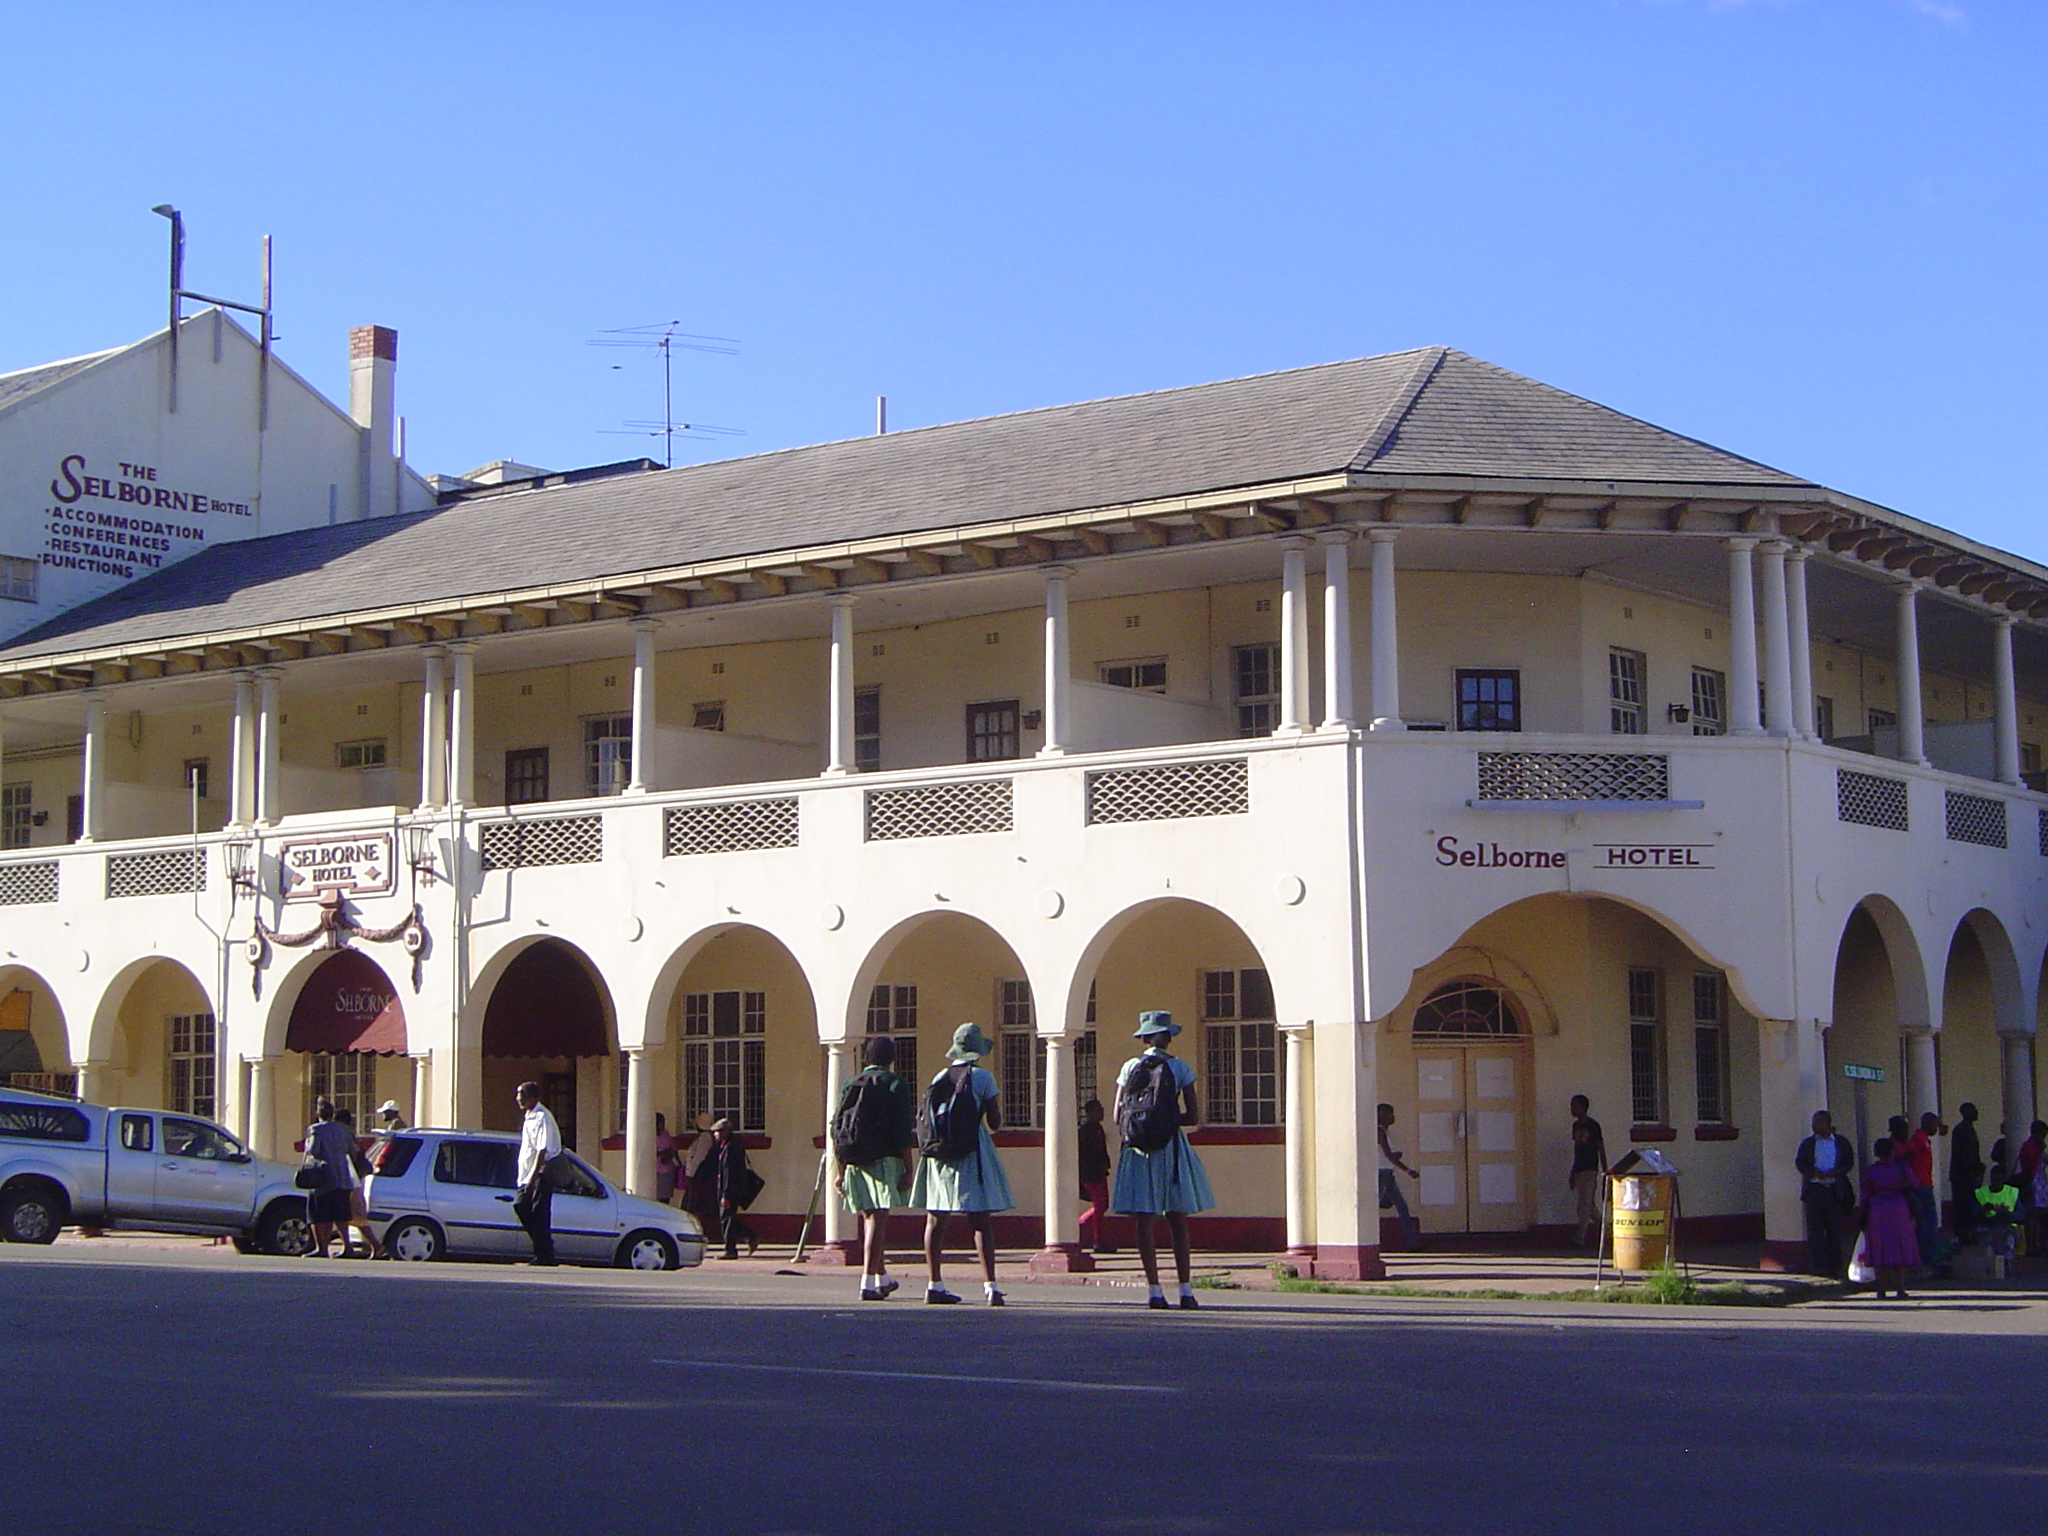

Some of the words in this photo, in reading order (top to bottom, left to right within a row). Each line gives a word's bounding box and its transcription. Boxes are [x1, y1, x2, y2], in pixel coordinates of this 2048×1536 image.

[118, 462, 157, 481] THE
[51, 454, 208, 513] SELBORNE
[211, 499, 252, 516] HOTEL
[52, 506, 204, 541] ACCOMMODATION
[51, 522, 170, 552] CONFERENCES
[42, 553, 134, 579] FUNCTIONS
[51, 538, 162, 568] RESTAURANT
[292, 844, 379, 867] SELBORNE
[1436, 836, 1566, 868] Selborne
[1608, 848, 1700, 866] HOTEL
[312, 866, 356, 882] HOTEL
[335, 987, 392, 1013] SELBORNE
[1615, 1219, 1664, 1227] DUNLOP
